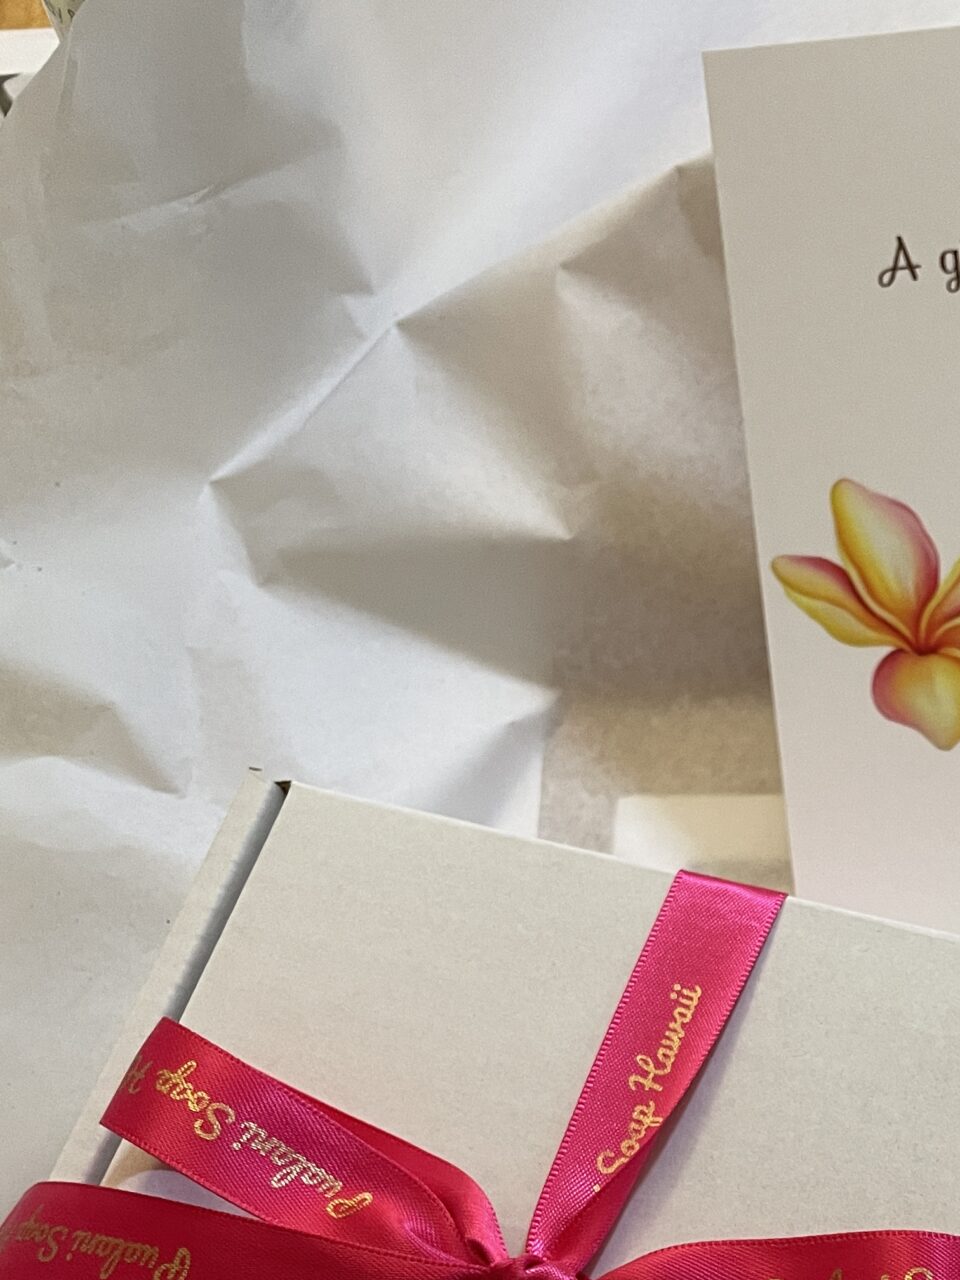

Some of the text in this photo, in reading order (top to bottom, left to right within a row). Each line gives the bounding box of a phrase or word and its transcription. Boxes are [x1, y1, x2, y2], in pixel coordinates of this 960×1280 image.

[878, 236, 921, 288] A
[628, 983, 702, 1092] Hawaii
[155, 1059, 236, 1140] Soap
[232, 1121, 373, 1219] Pualani
